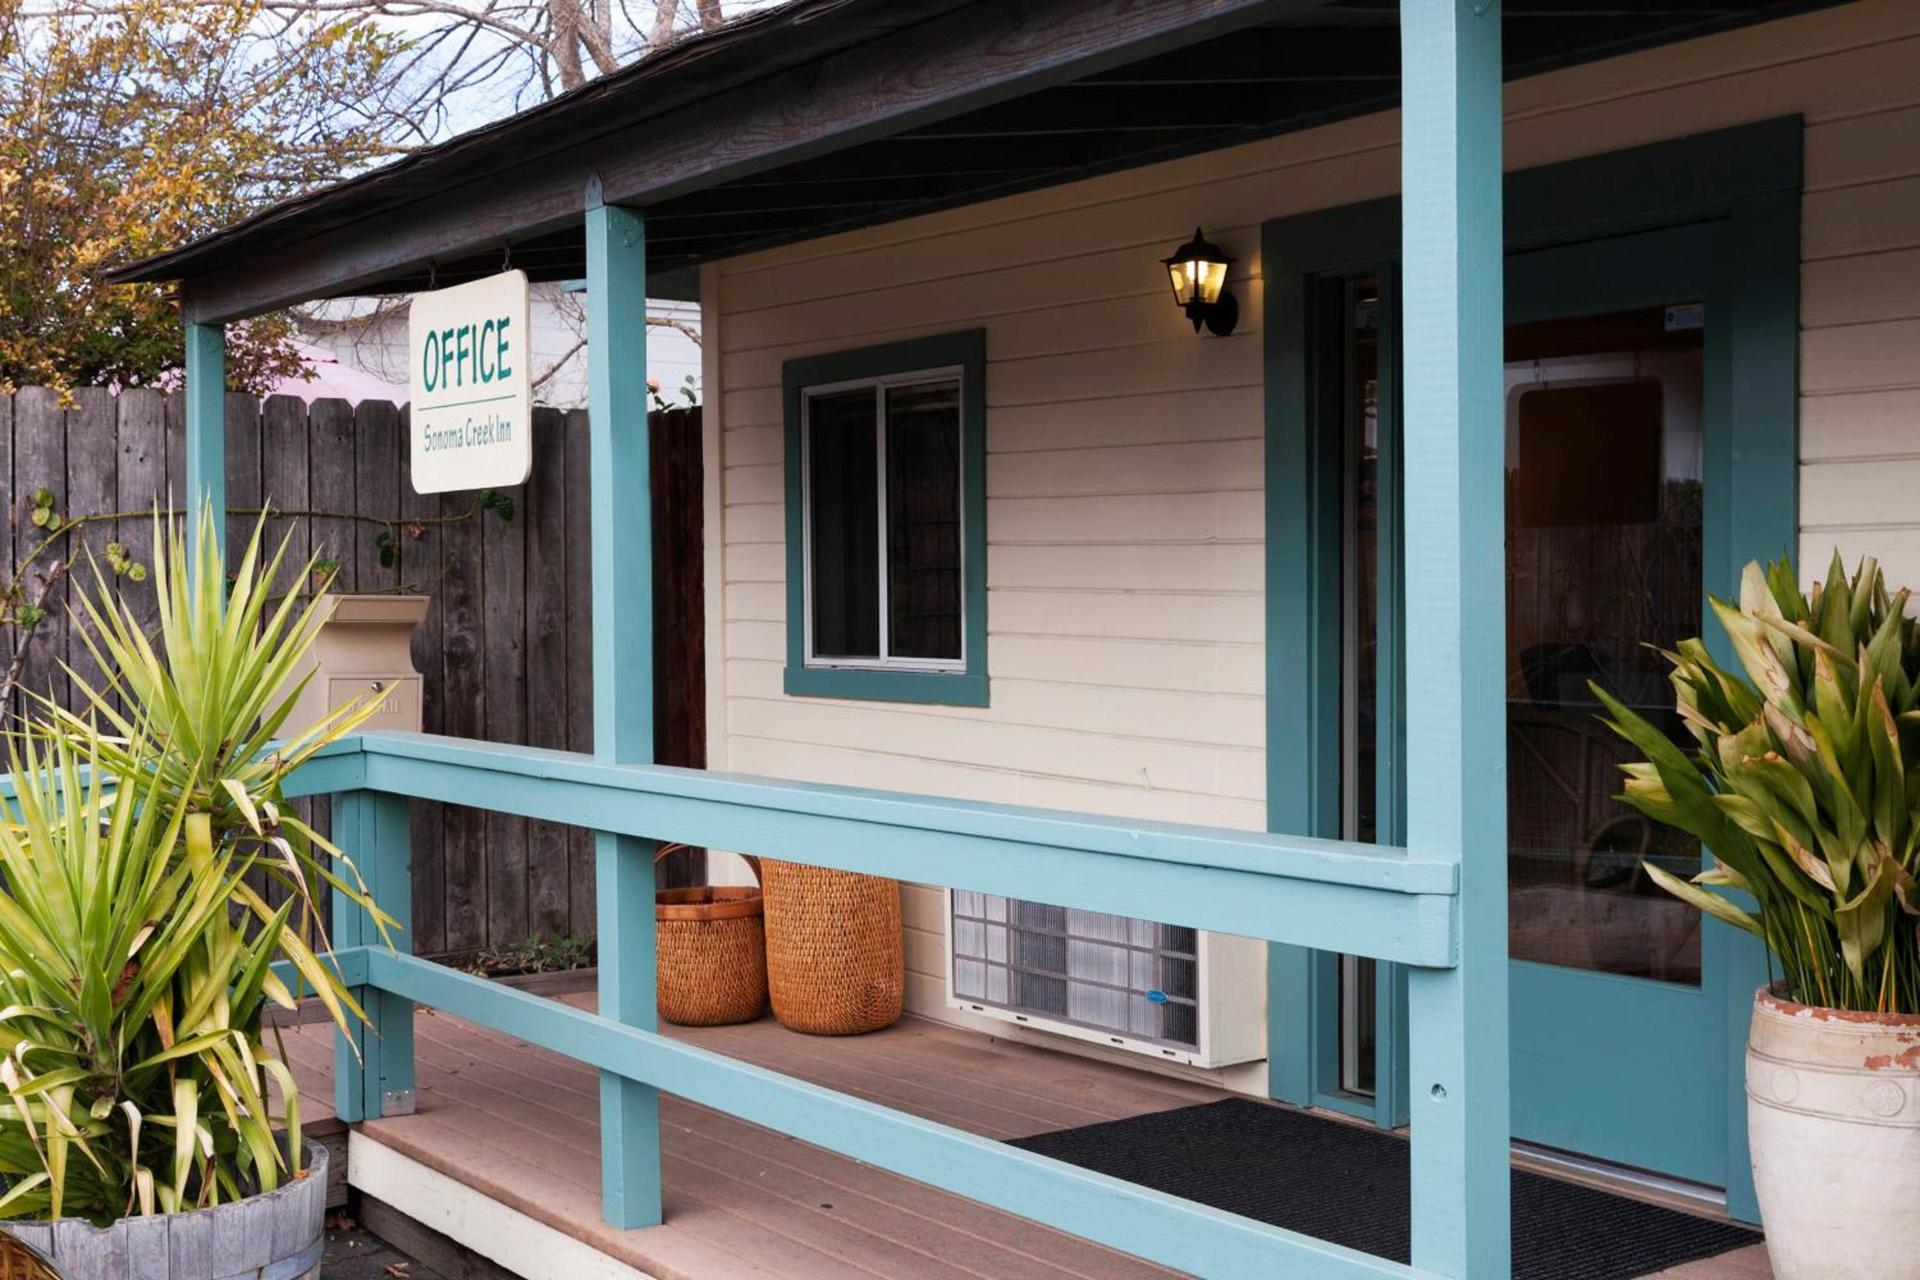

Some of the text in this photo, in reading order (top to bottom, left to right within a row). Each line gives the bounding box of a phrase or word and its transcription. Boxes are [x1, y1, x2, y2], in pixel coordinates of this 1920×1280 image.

[423, 316, 512, 393] OFFICE
[424, 413, 512, 452] Sonoma Creek Inn
